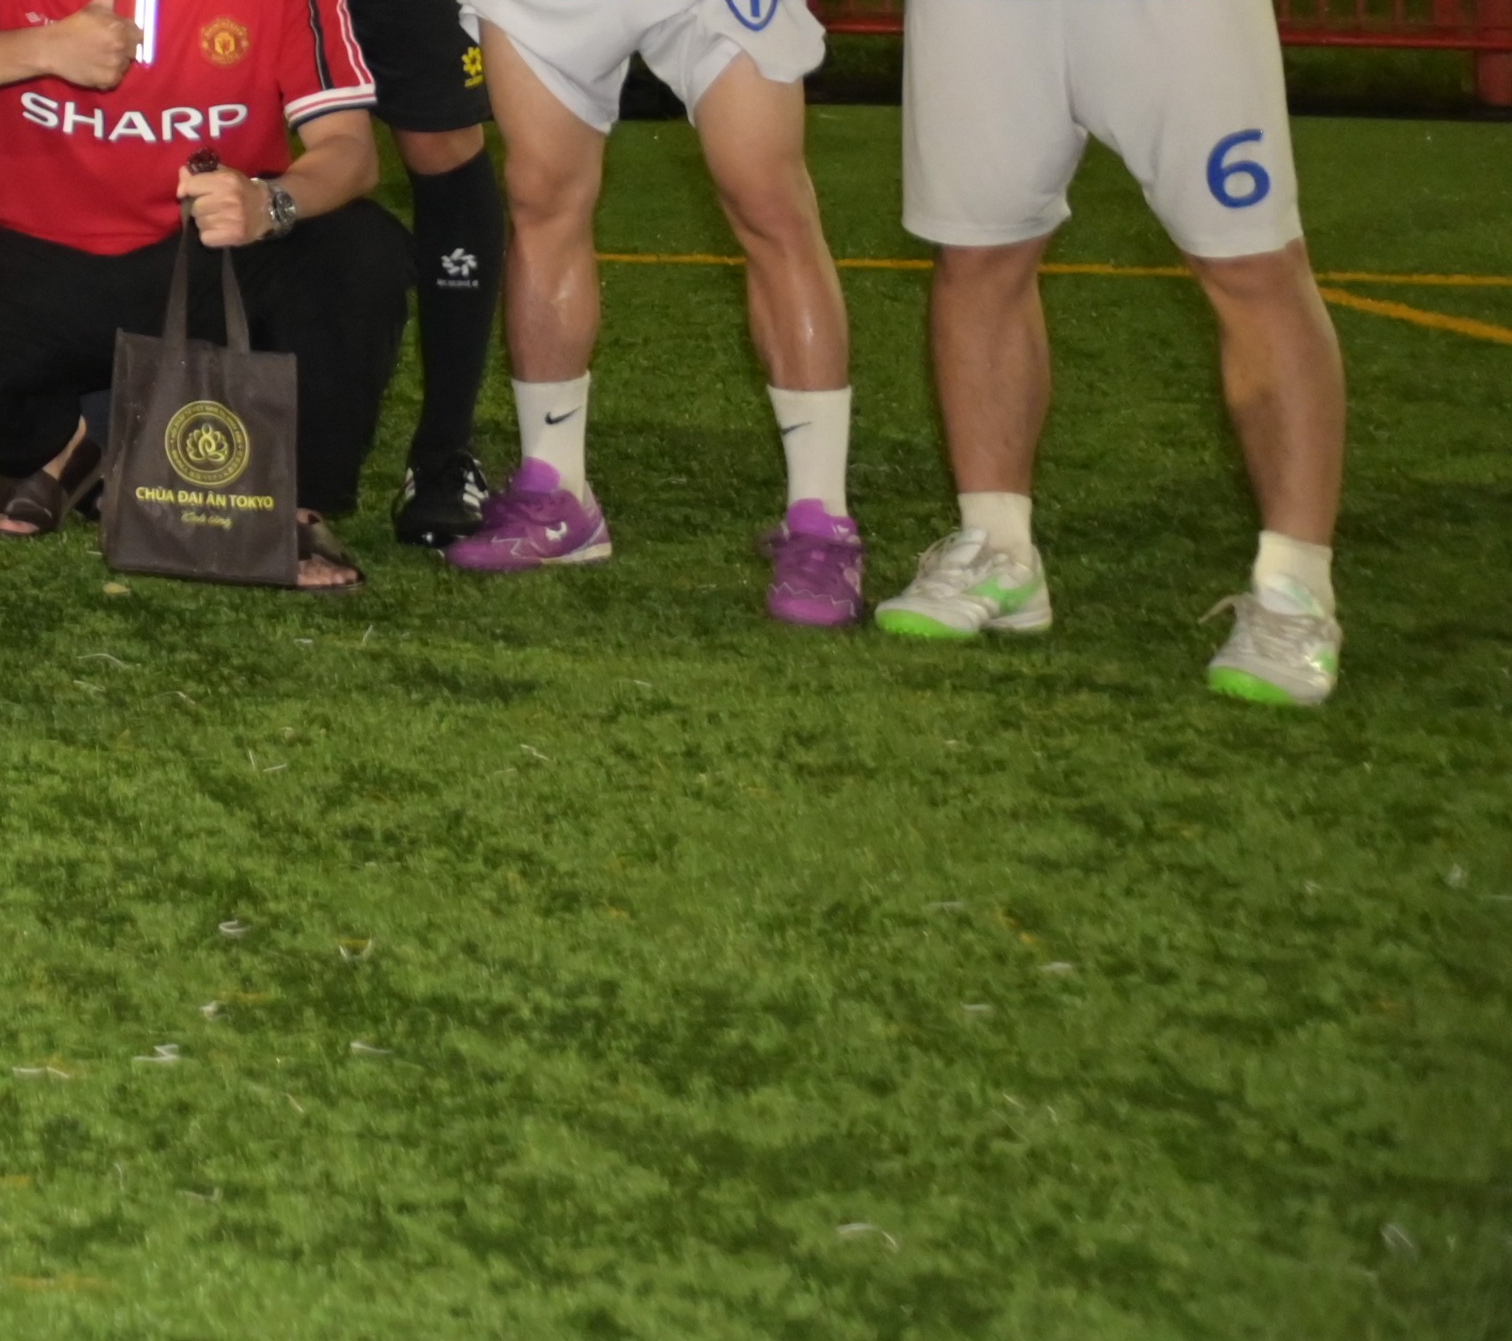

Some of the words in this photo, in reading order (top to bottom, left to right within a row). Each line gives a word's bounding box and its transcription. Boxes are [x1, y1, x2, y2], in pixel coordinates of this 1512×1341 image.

[20, 91, 249, 145] SHARP
[1206, 128, 1271, 209] 6
[134, 485, 174, 503] CHÙA
[204, 489, 227, 506] ÂN
[228, 494, 275, 511] TOKYO
